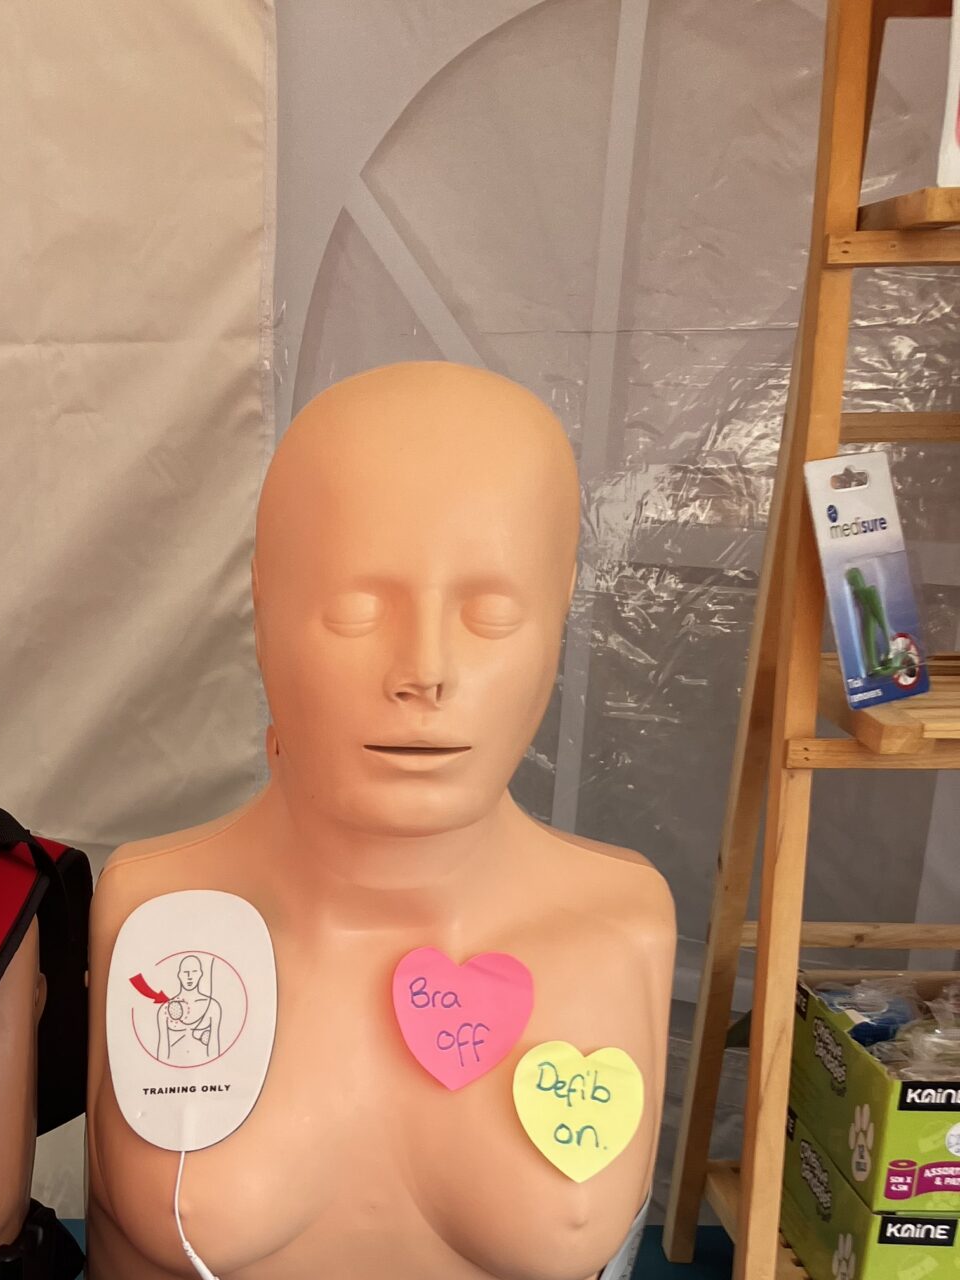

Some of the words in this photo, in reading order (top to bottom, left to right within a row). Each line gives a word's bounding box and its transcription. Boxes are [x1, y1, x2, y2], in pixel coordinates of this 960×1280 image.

[830, 516, 888, 539] medisure
[409, 976, 462, 1009] Bra
[142, 1086, 197, 1096] TRAINING
[201, 1084, 232, 1094] ONLY
[535, 1061, 612, 1107] Defib
